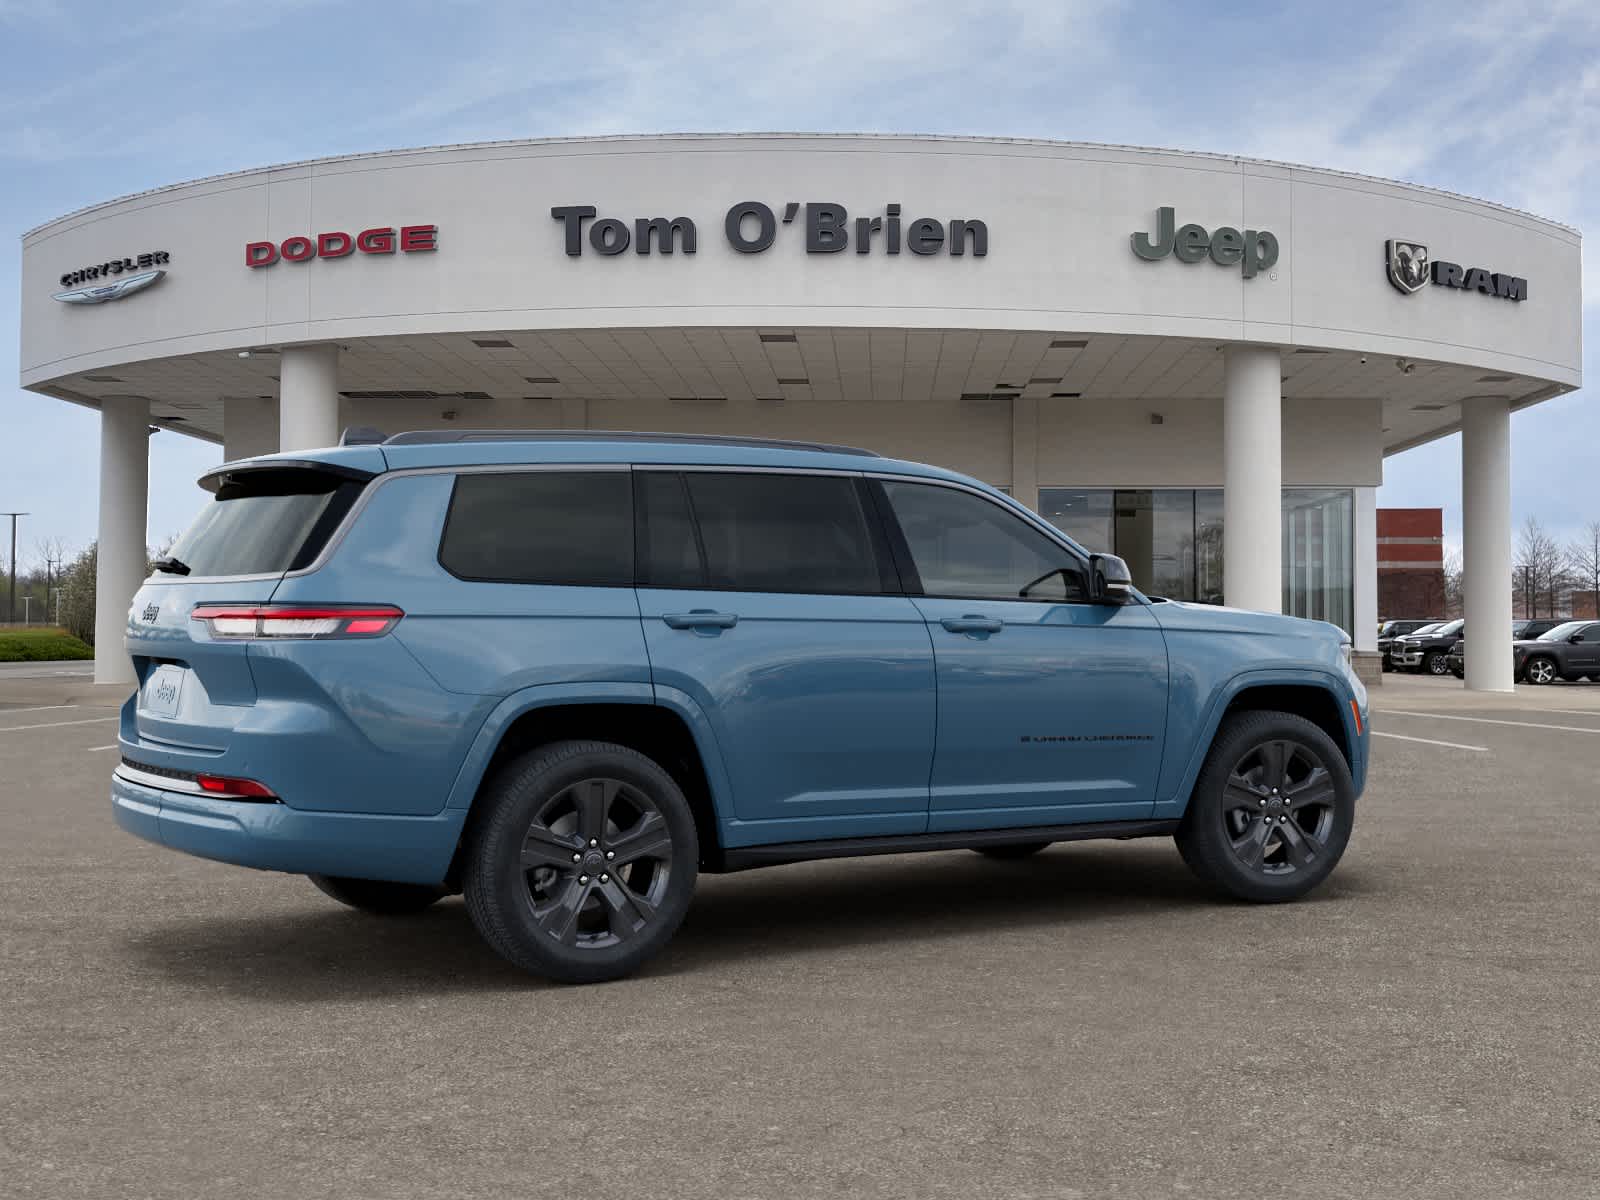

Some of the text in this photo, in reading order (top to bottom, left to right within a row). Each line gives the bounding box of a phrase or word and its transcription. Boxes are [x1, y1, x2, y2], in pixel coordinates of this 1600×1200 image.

[245, 224, 438, 269] DODGE
[551, 200, 988, 257] Tom O'Brien
[1130, 206, 1279, 279] Jeep
[59, 250, 170, 288] CHRYSLER
[1431, 260, 1527, 301] RAM
